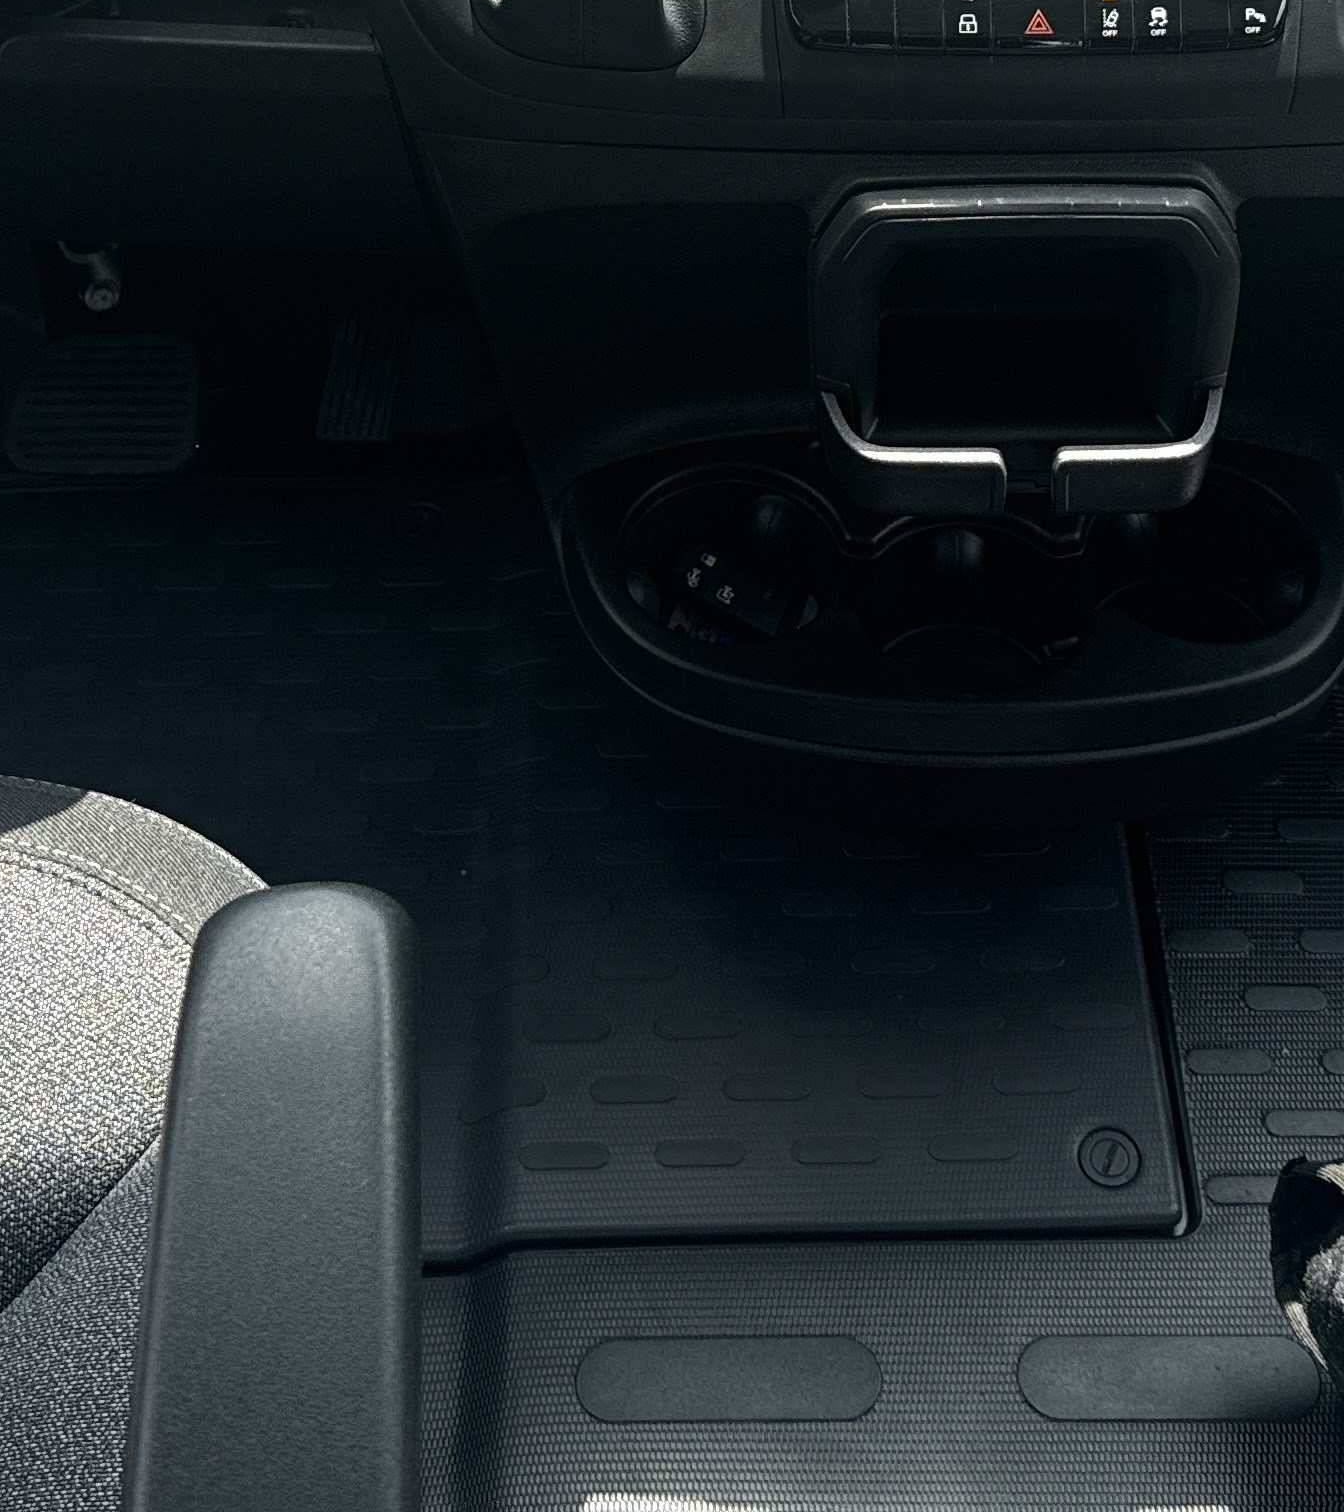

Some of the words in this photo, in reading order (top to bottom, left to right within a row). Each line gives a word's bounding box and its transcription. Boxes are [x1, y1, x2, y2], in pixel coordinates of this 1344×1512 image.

[1101, 28, 1118, 38] OFF
[1150, 28, 1167, 37] OFF
[1244, 25, 1262, 34] OFF
